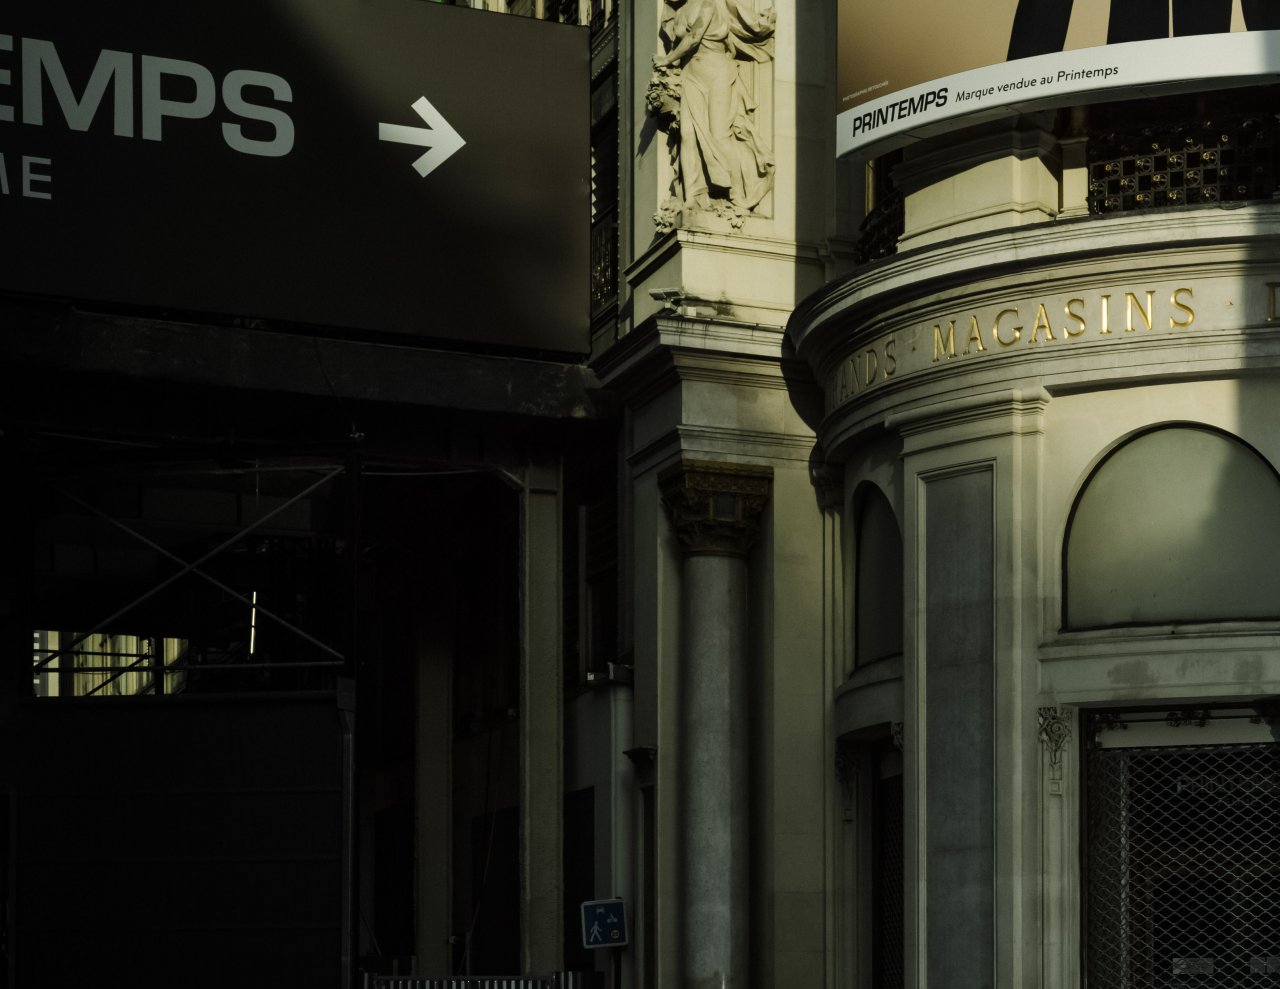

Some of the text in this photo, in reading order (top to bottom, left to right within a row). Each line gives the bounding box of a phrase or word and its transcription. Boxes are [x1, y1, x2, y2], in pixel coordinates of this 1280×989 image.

[0, 33, 295, 158] MPS
[852, 87, 949, 137] PRINTEMPS
[955, 84, 995, 103] Marque
[997, 77, 1038, 94] vendue
[1040, 75, 1054, 86] au
[1056, 64, 1119, 83] Printemps
[0, 152, 53, 200] E
[931, 287, 1196, 364] MAGASINS
